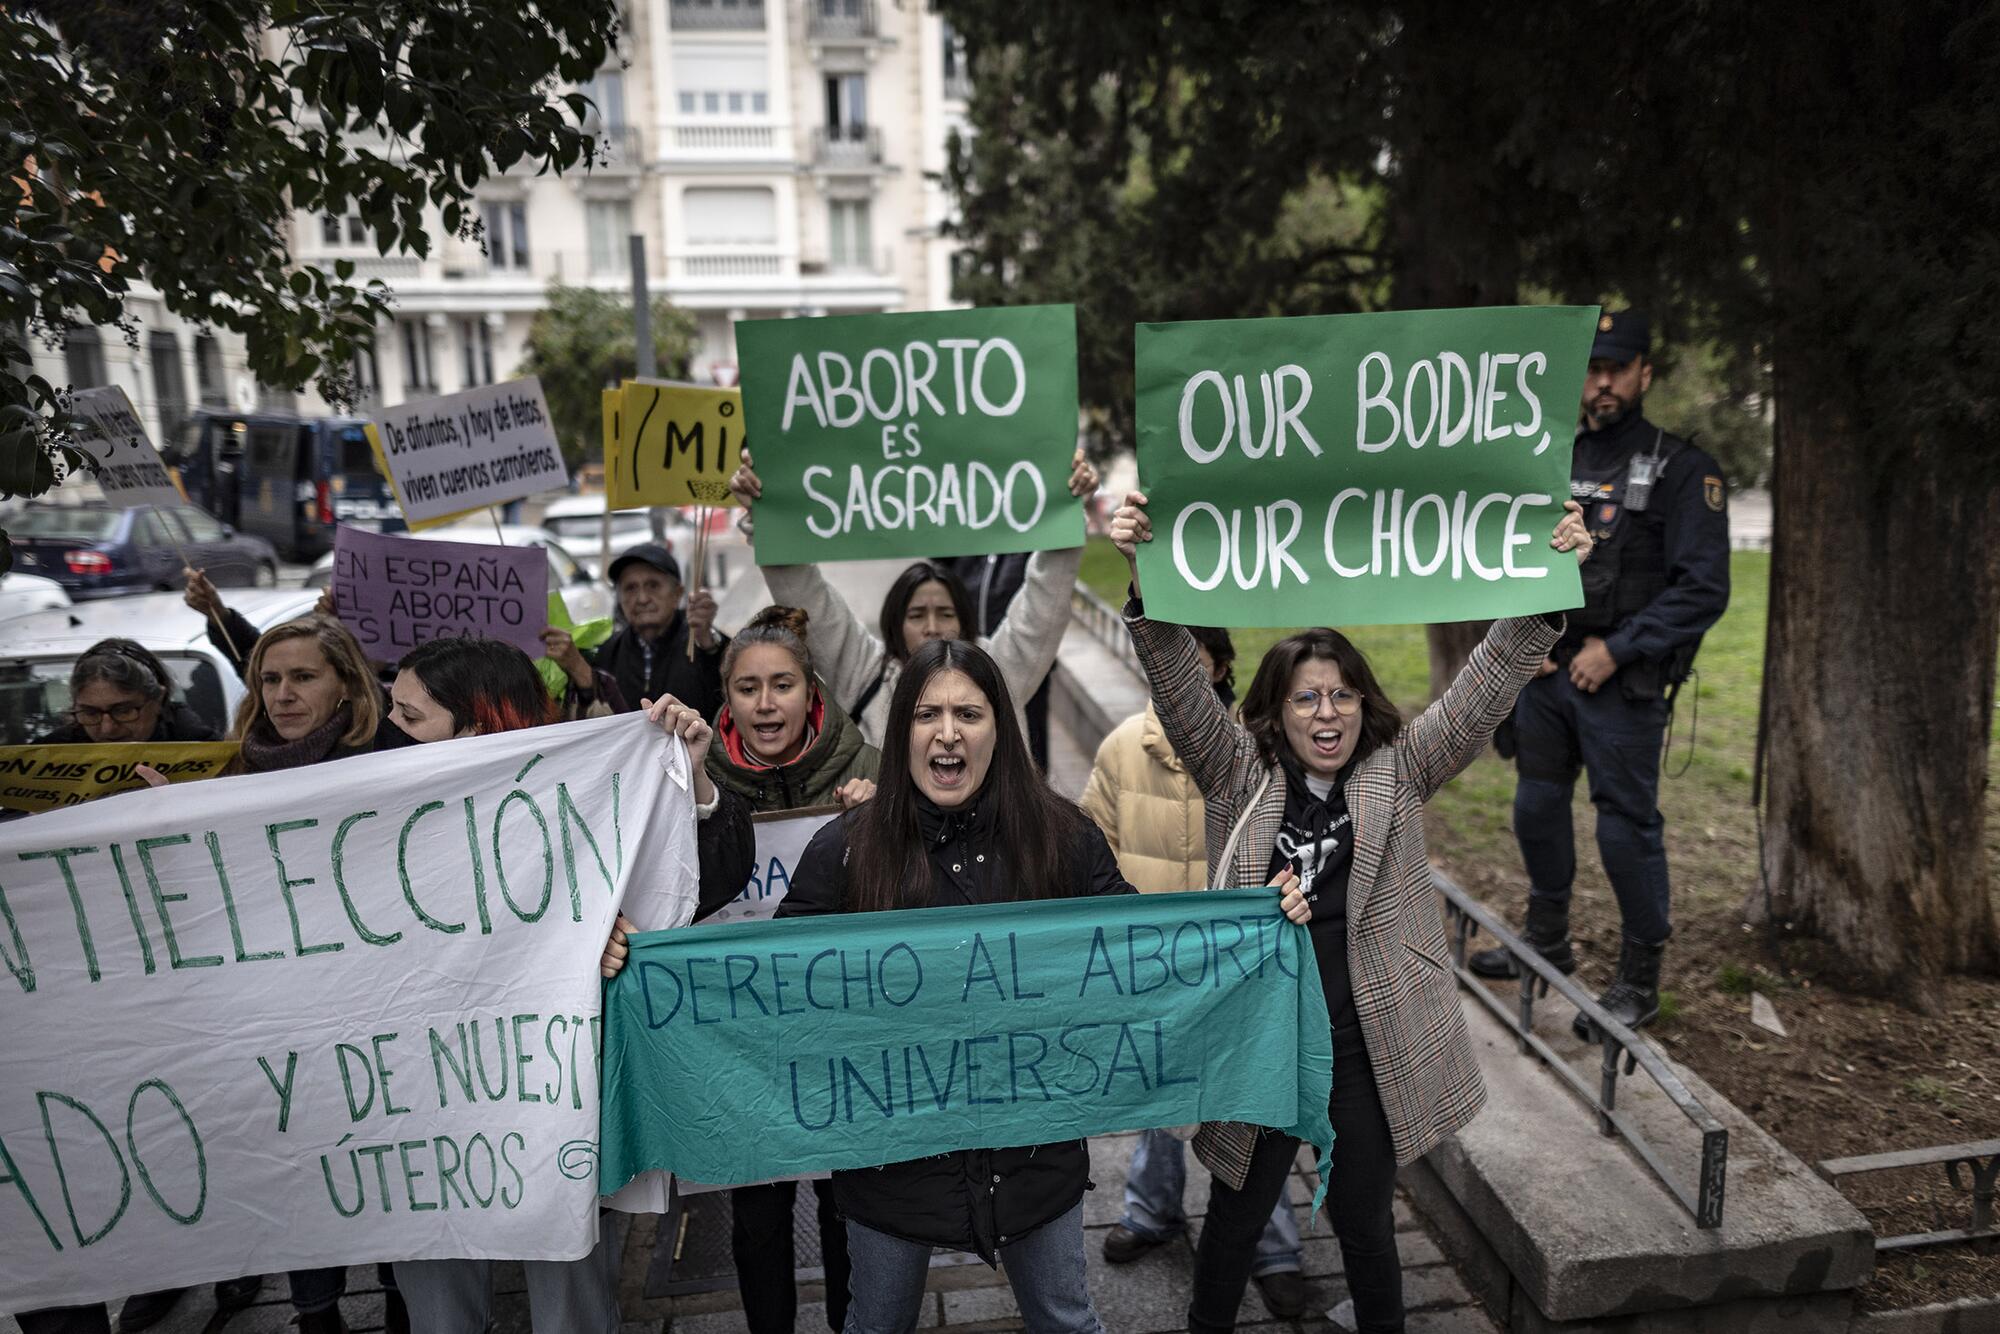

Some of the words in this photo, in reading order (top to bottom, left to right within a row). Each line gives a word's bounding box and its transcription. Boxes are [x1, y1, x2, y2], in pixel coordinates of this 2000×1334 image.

[782, 336, 1026, 431] ABORTO
[1178, 364, 1323, 464] OUR
[1356, 350, 1551, 456] BODIES,
[384, 421, 407, 456] De
[494, 399, 511, 432] de
[881, 422, 922, 460] ES
[402, 469, 439, 505] viven
[438, 462, 491, 495] cuervos
[802, 459, 1046, 539] SAGRADO
[336, 550, 369, 580] EN
[385, 556, 525, 594] ESPAÑA
[1172, 498, 1309, 591] OUR
[1324, 487, 1552, 581] CHOICE
[335, 583, 372, 613] EL
[389, 589, 524, 626] ABORTO
[339, 615, 380, 644] S
[37, 762, 92, 777] MIS
[731, 856, 791, 904] RA
[638, 940, 925, 1030] DERECHO
[961, 932, 1047, 1003] AL
[334, 1032, 412, 1123] DE
[788, 1021, 1198, 1132] UNIVERSAL
[320, 1131, 526, 1219] ÚTEROS
